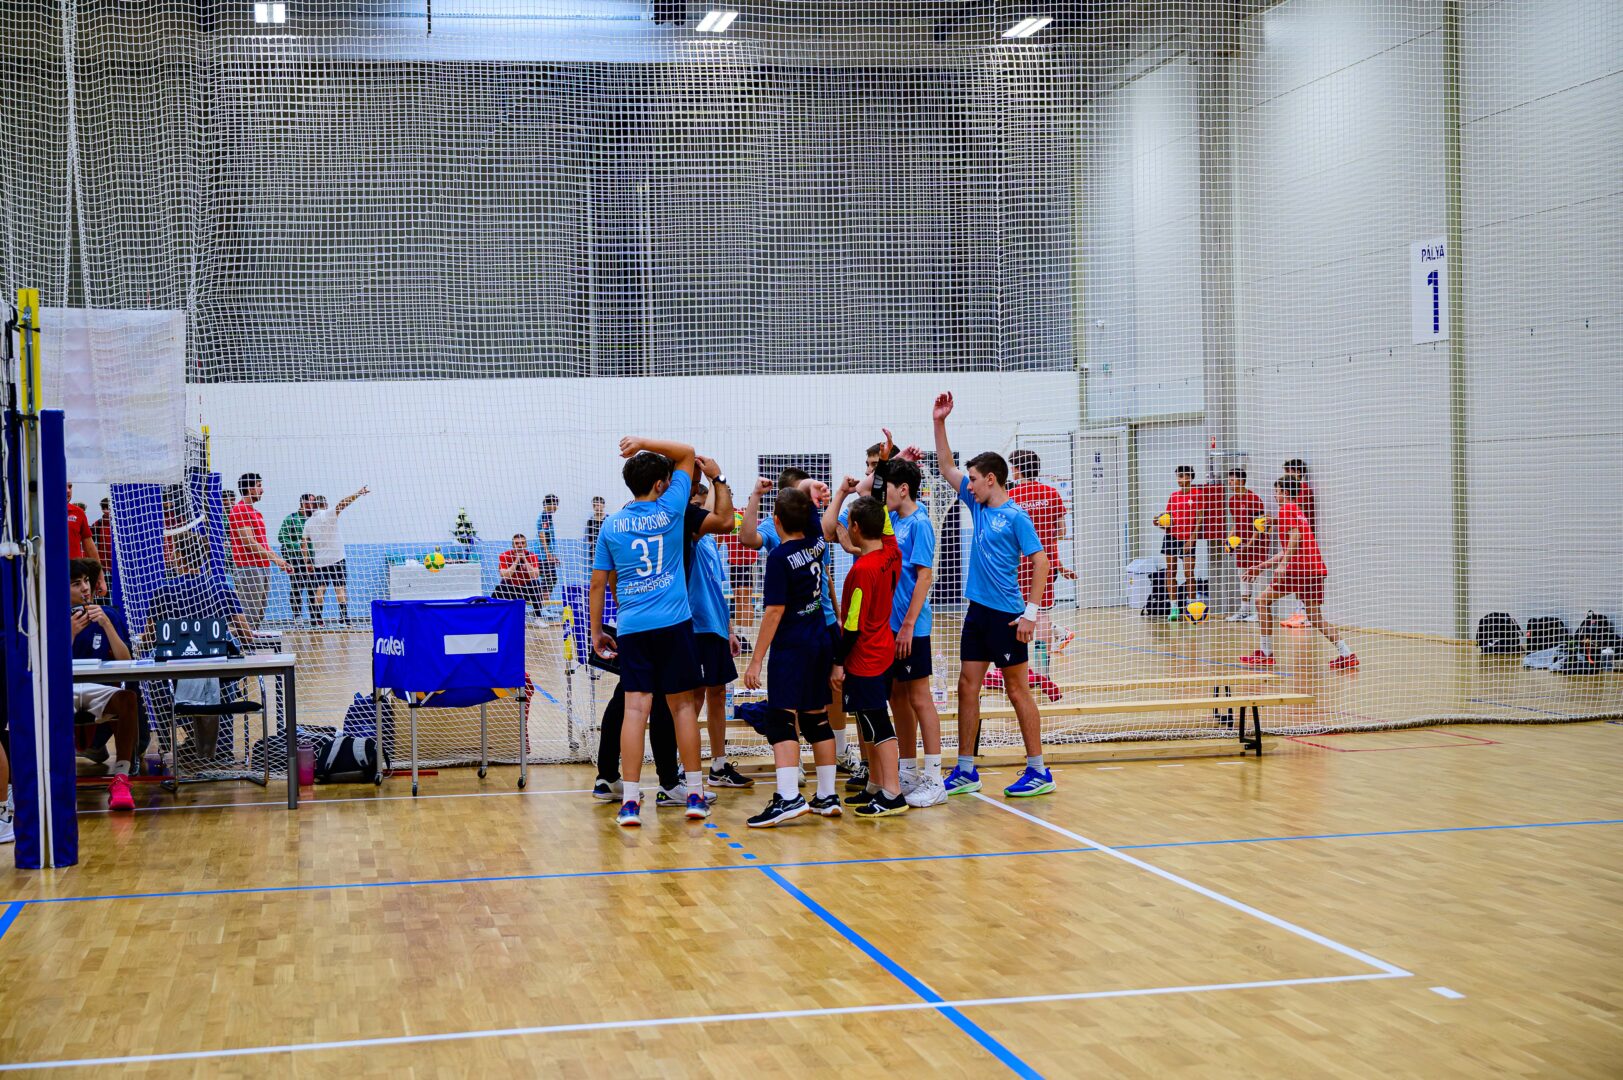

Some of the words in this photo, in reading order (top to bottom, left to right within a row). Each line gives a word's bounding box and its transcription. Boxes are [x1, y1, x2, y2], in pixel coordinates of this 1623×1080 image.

[1427, 270, 1439, 334] 1
[613, 517, 630, 534] FINO
[631, 534, 664, 577] 37
[162, 622, 171, 641] 0
[181, 621, 188, 632] 0
[194, 621, 201, 632] 0
[212, 621, 220, 639] 0
